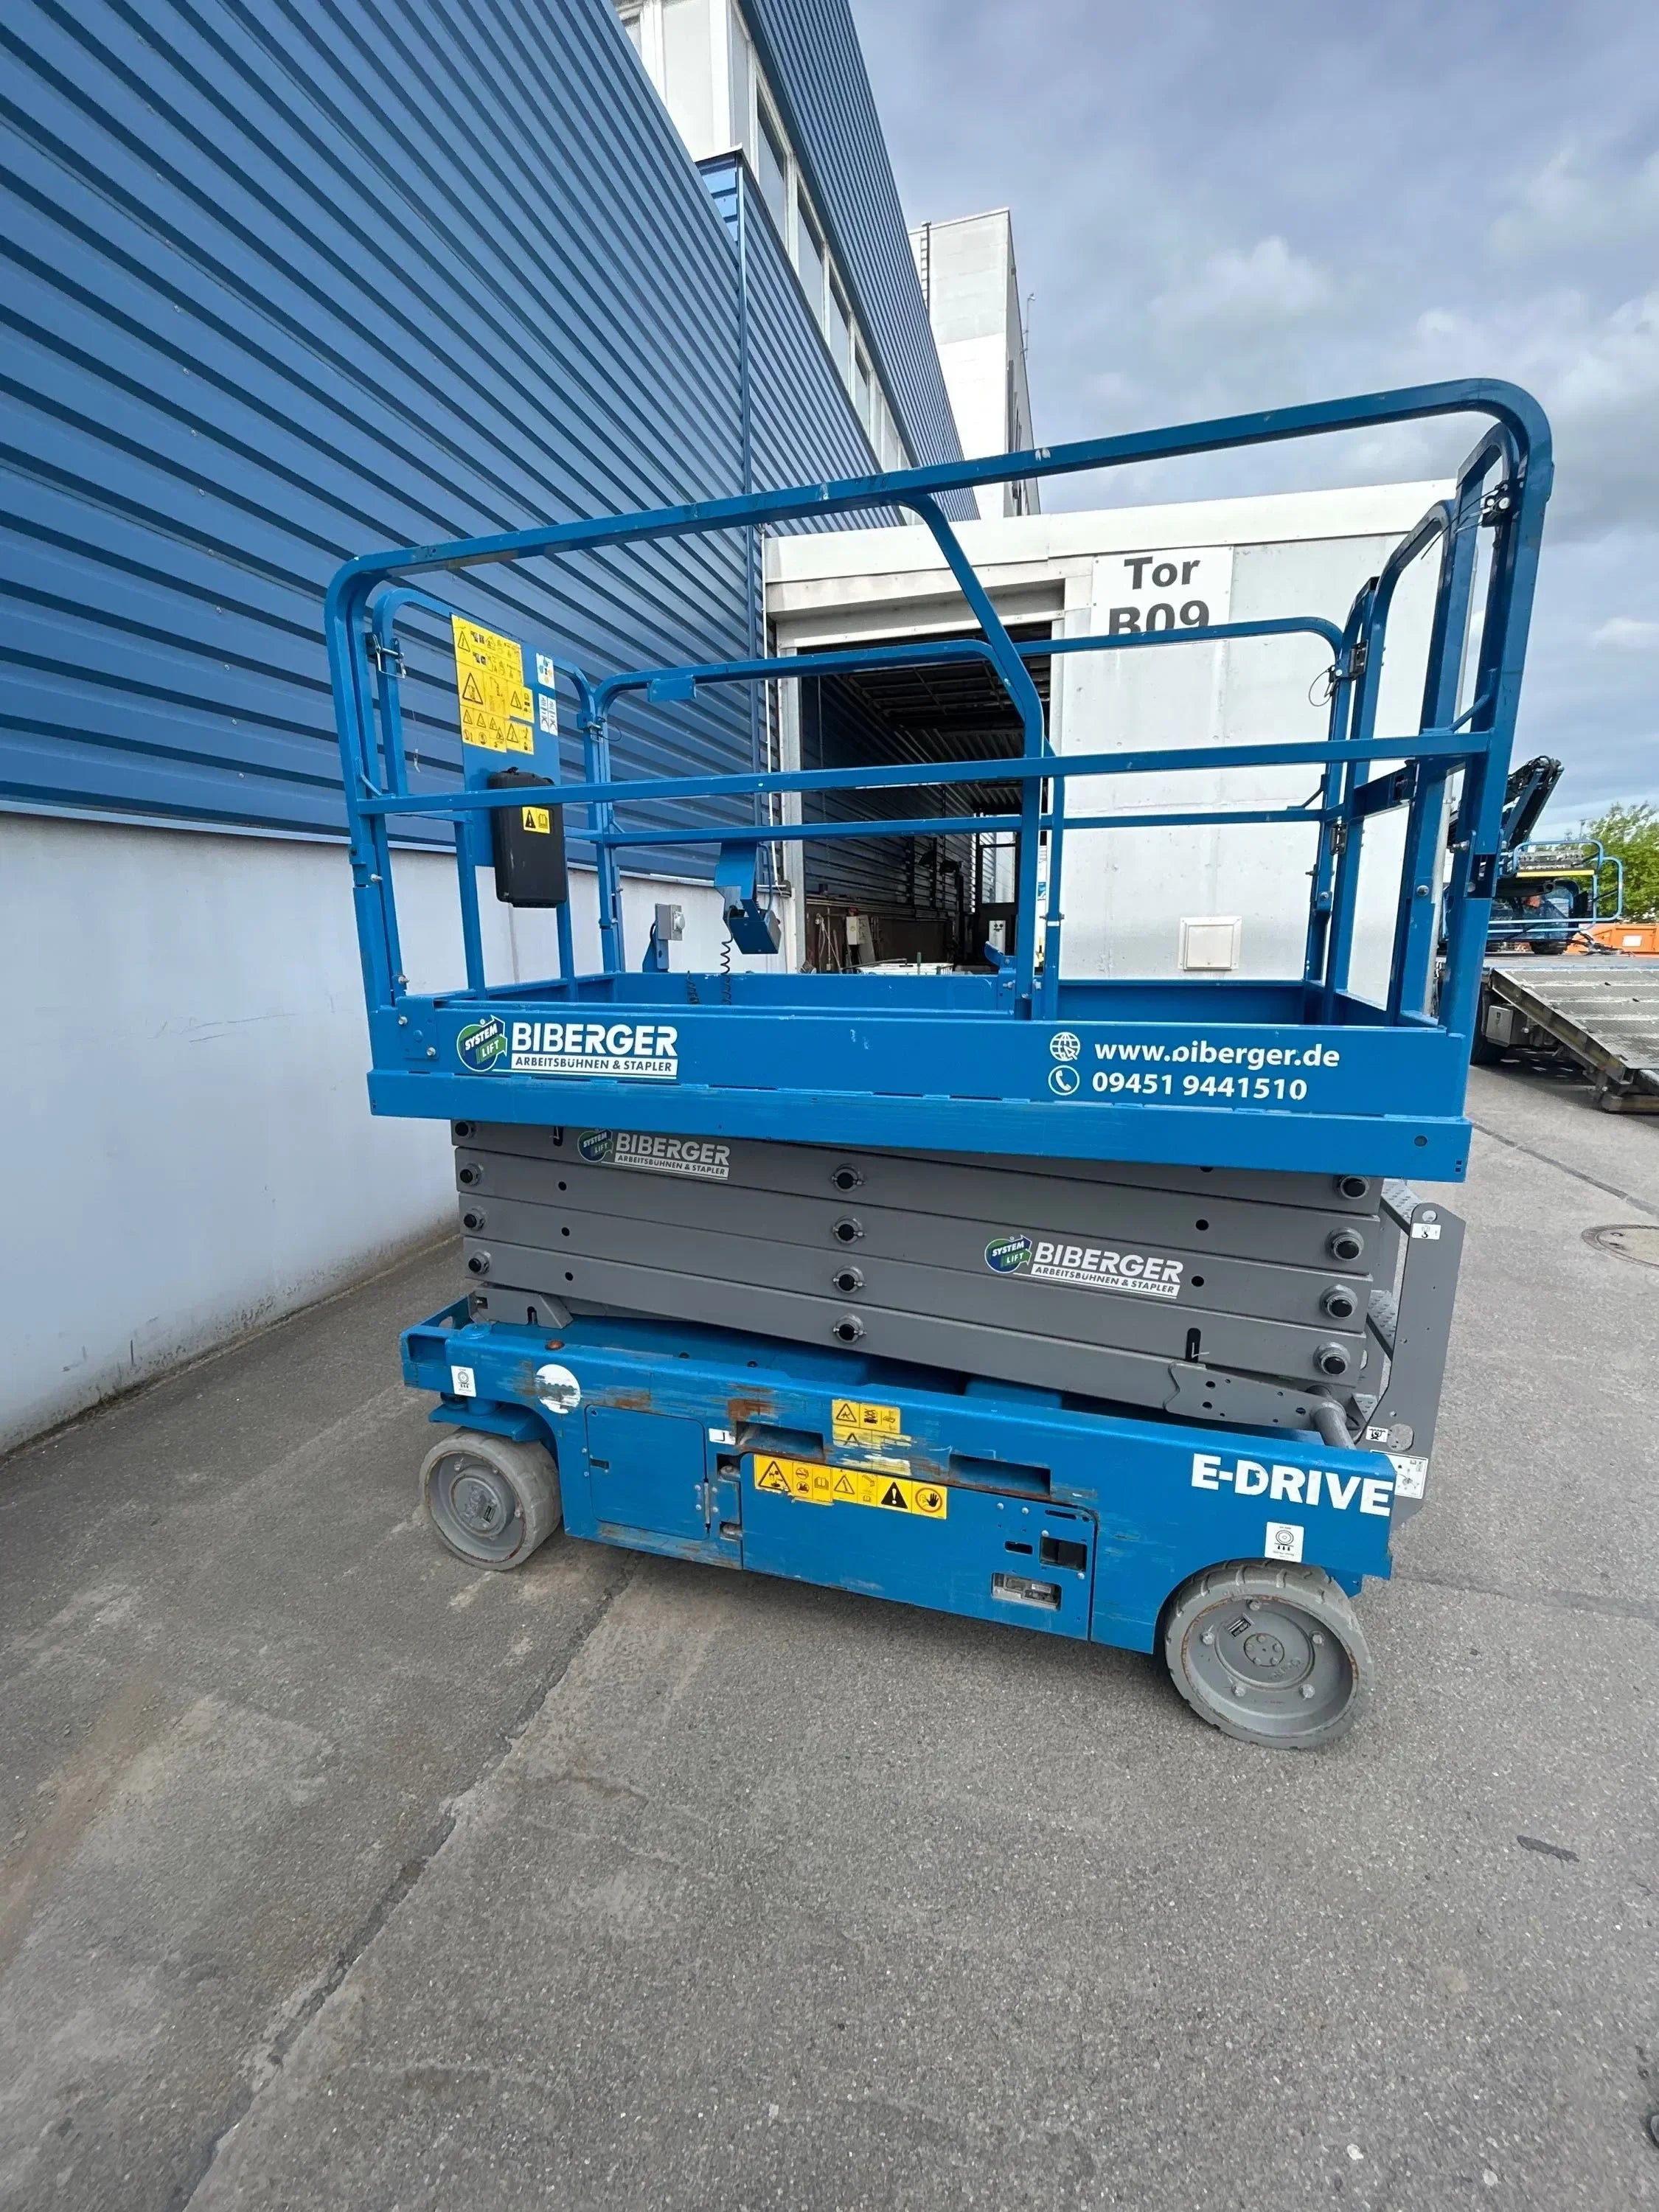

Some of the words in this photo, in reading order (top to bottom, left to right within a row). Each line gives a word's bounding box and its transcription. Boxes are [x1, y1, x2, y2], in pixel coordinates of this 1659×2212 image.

[1124, 557, 1200, 590] Tor
[1108, 600, 1209, 635] B09
[465, 1023, 498, 1051] SYSTEM
[512, 1022, 678, 1056] BIBERGER
[481, 1040, 500, 1057] LIFT
[515, 1057, 609, 1070] ARBEITSBÜHNEN
[612, 1058, 621, 1070] &
[624, 1060, 672, 1072] STAPLER
[1092, 1071, 1173, 1095] 09451
[1183, 1075, 1307, 1101] 9441510
[582, 1131, 608, 1148] SYSTEM
[594, 1143, 608, 1153] LIFT
[616, 1133, 731, 1166] BIBERGER
[692, 1164, 726, 1175] STAPLER
[992, 1241, 1025, 1257] SYSTEM
[1006, 1253, 1024, 1263] LIFT
[1034, 1242, 1183, 1283] BIBERGER
[1121, 1279, 1129, 1287] &
[1130, 1280, 1175, 1294] STAPLER
[1191, 1453, 1394, 1517] E-DRIVE
